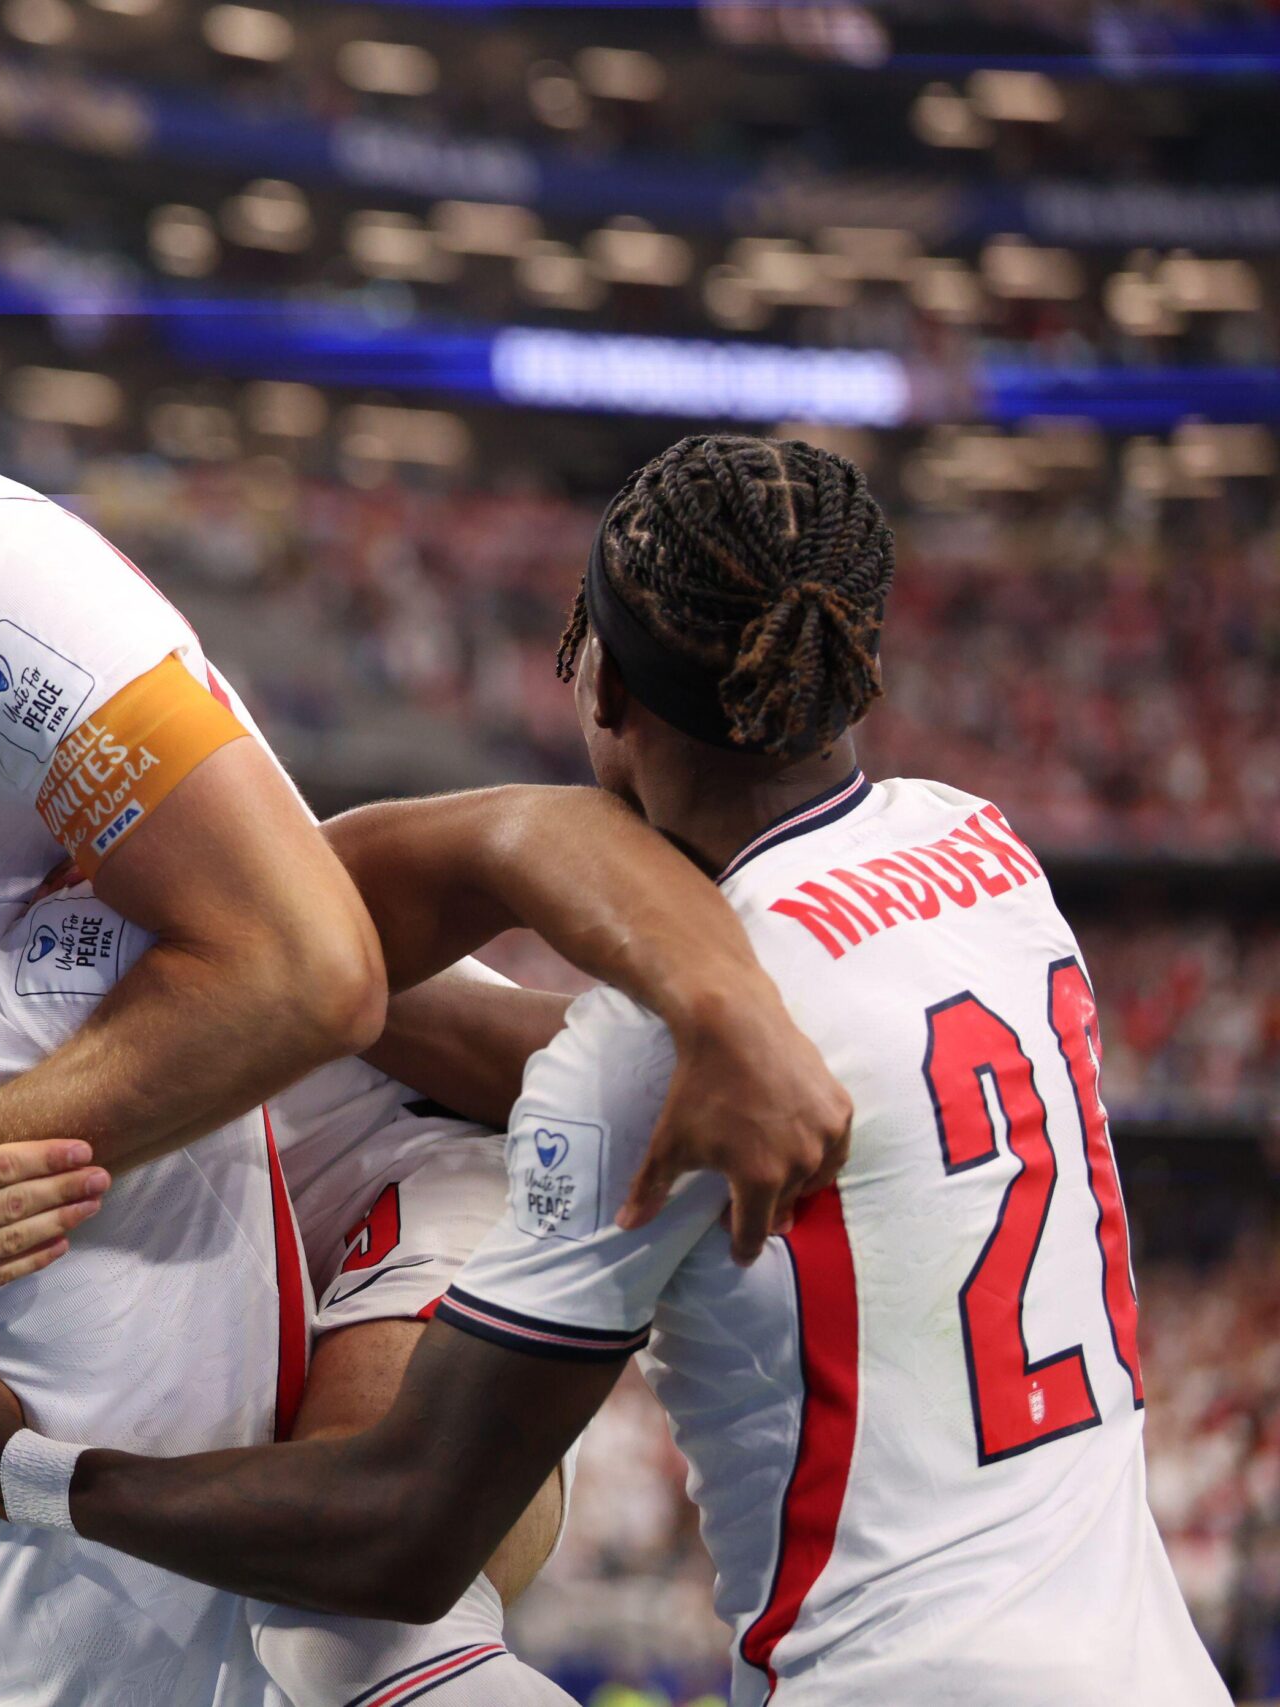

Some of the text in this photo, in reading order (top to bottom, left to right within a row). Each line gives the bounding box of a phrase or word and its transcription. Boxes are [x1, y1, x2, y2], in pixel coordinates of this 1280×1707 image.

[2, 666, 41, 724] Unite For
[22, 679, 64, 733] PEACE
[46, 706, 69, 733] FIFA
[44, 733, 129, 836] UNITES
[83, 746, 161, 826] World
[96, 807, 141, 850] FIFA
[55, 912, 80, 971] Unite For
[75, 916, 104, 968] PEACE
[100, 929, 114, 958] FIFA
[527, 1192, 572, 1221] PEACE
[555, 1174, 576, 1197] For
